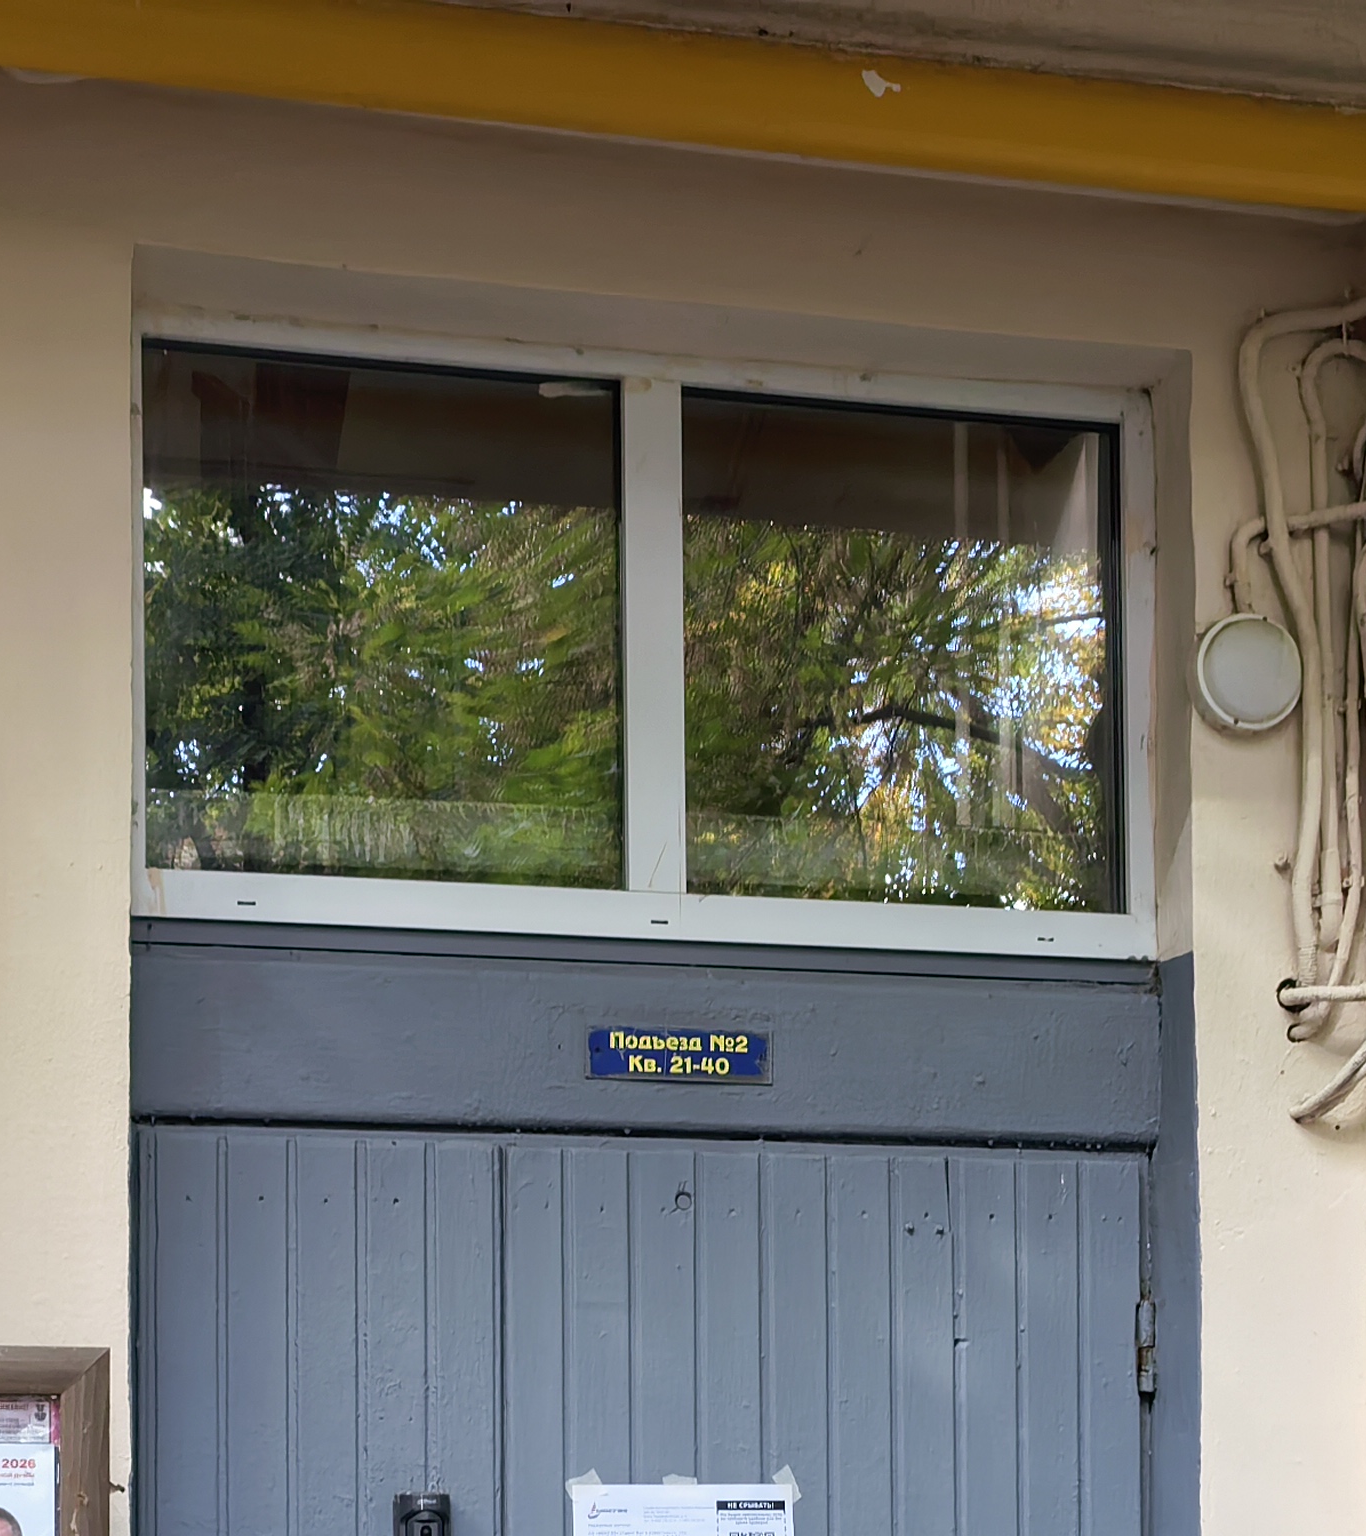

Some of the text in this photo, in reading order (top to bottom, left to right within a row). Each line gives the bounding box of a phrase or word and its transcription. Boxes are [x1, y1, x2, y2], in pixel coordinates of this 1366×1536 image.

[710, 1034, 748, 1053] №2
[629, 1055, 730, 1075] Кв. 21-40
[2, 1458, 36, 1469] 2026
